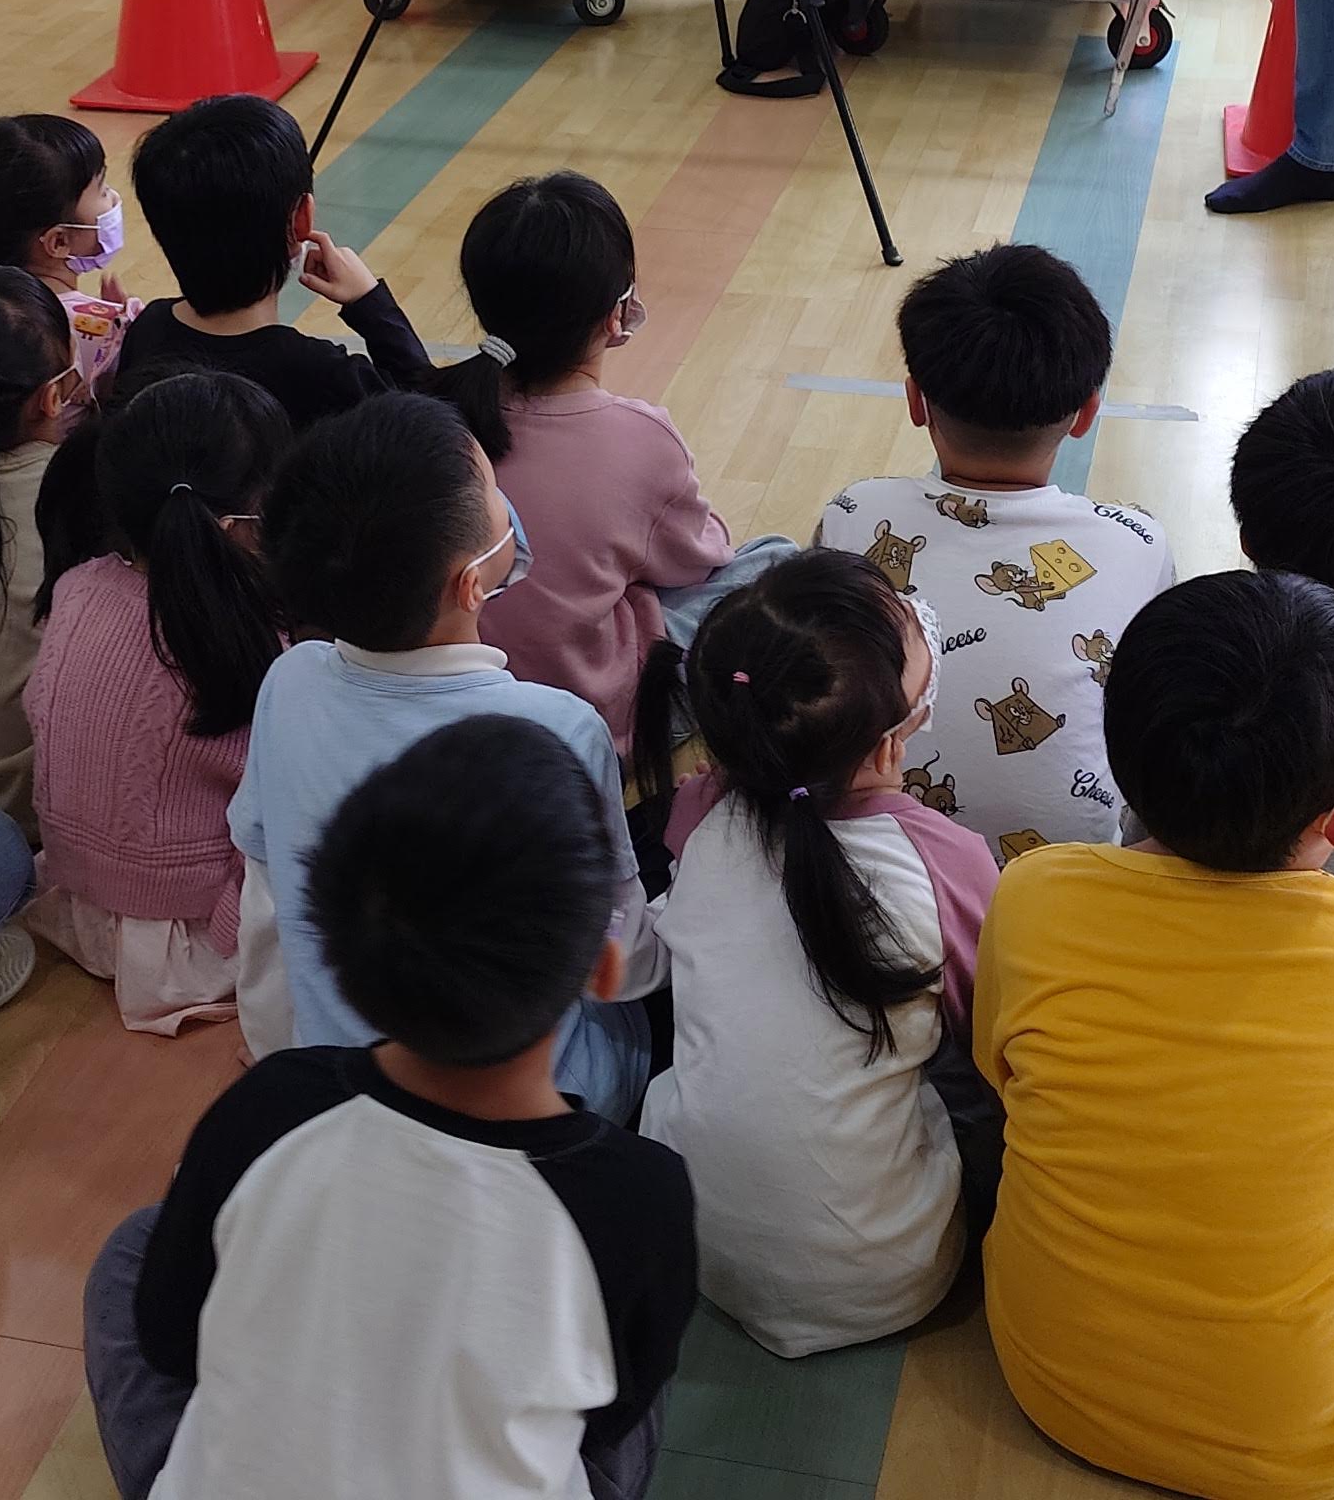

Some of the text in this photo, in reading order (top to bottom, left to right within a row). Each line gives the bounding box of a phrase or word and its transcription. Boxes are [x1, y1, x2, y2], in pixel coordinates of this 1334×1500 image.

[1092, 501, 1154, 545] Cheese
[940, 627, 987, 656] eese
[1070, 768, 1115, 809] Cheese
